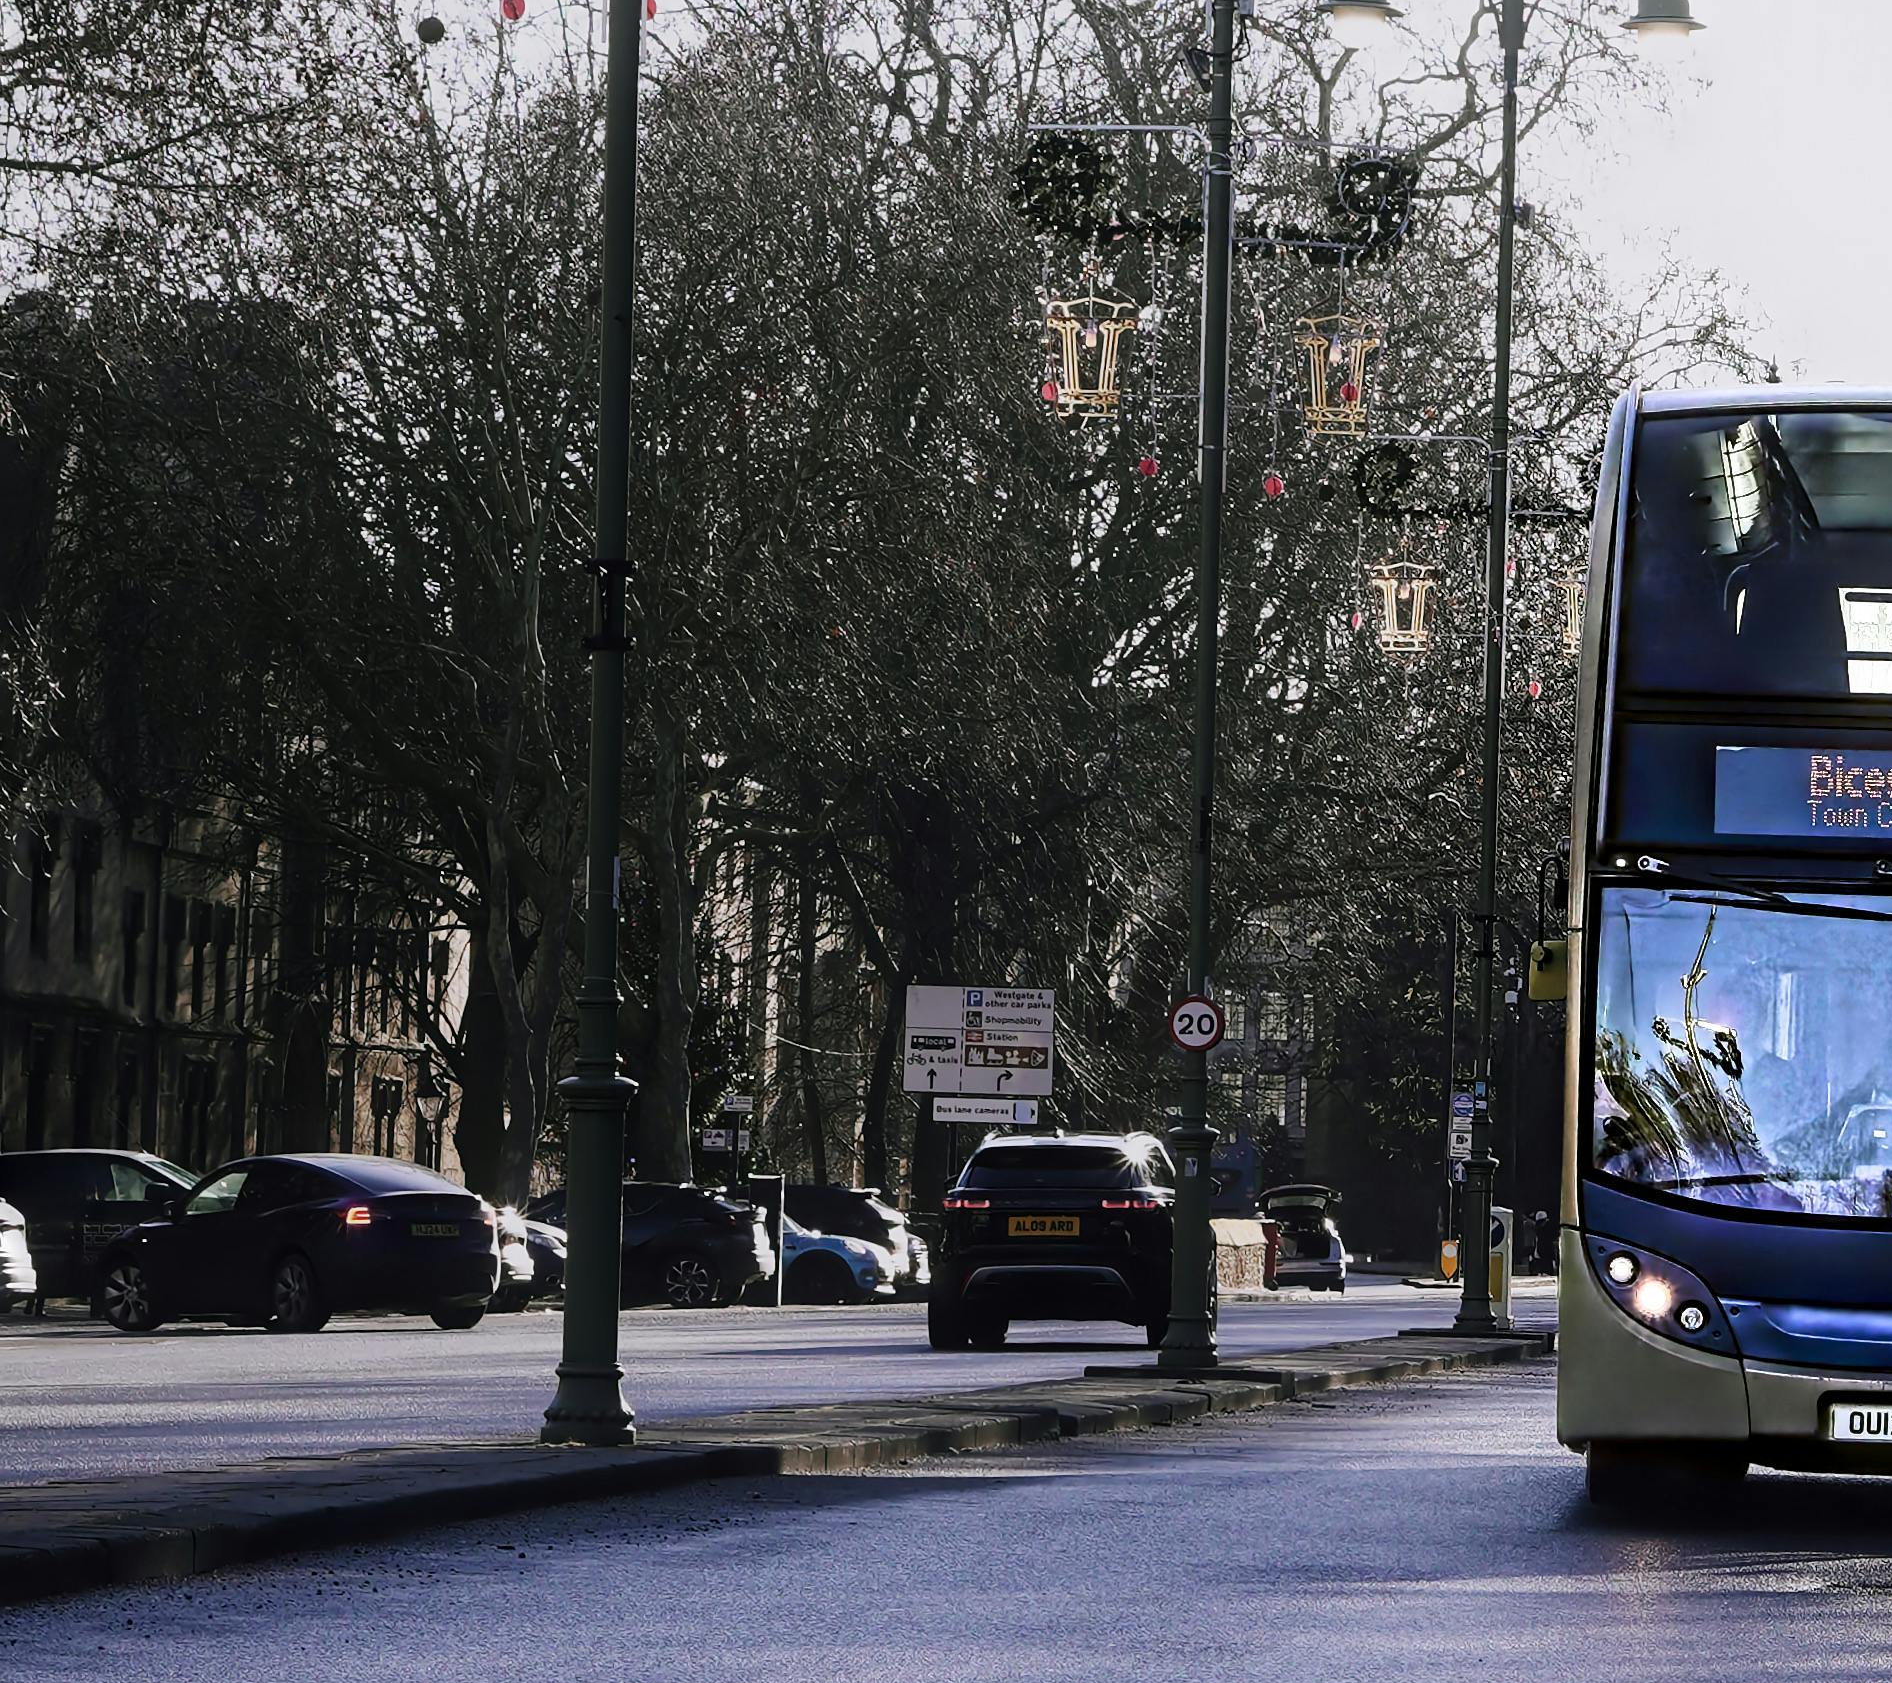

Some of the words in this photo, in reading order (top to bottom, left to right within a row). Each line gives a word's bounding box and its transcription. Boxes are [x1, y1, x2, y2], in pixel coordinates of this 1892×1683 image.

[1807, 799, 1868, 827] Town
[994, 991, 1035, 1000] Westgate
[1037, 992, 1044, 1000] &
[985, 1000, 1009, 1008] other
[1027, 1001, 1051, 1010] parks
[984, 1015, 1042, 1026] Shopmobility
[1178, 1013, 1215, 1035] 20
[925, 1036, 947, 1045] local
[986, 1033, 1018, 1041] Station
[937, 1055, 958, 1064] taxis
[936, 1105, 952, 1113] Bus
[954, 1105, 972, 1114] lane
[1049, 1221, 1074, 1231] ARD
